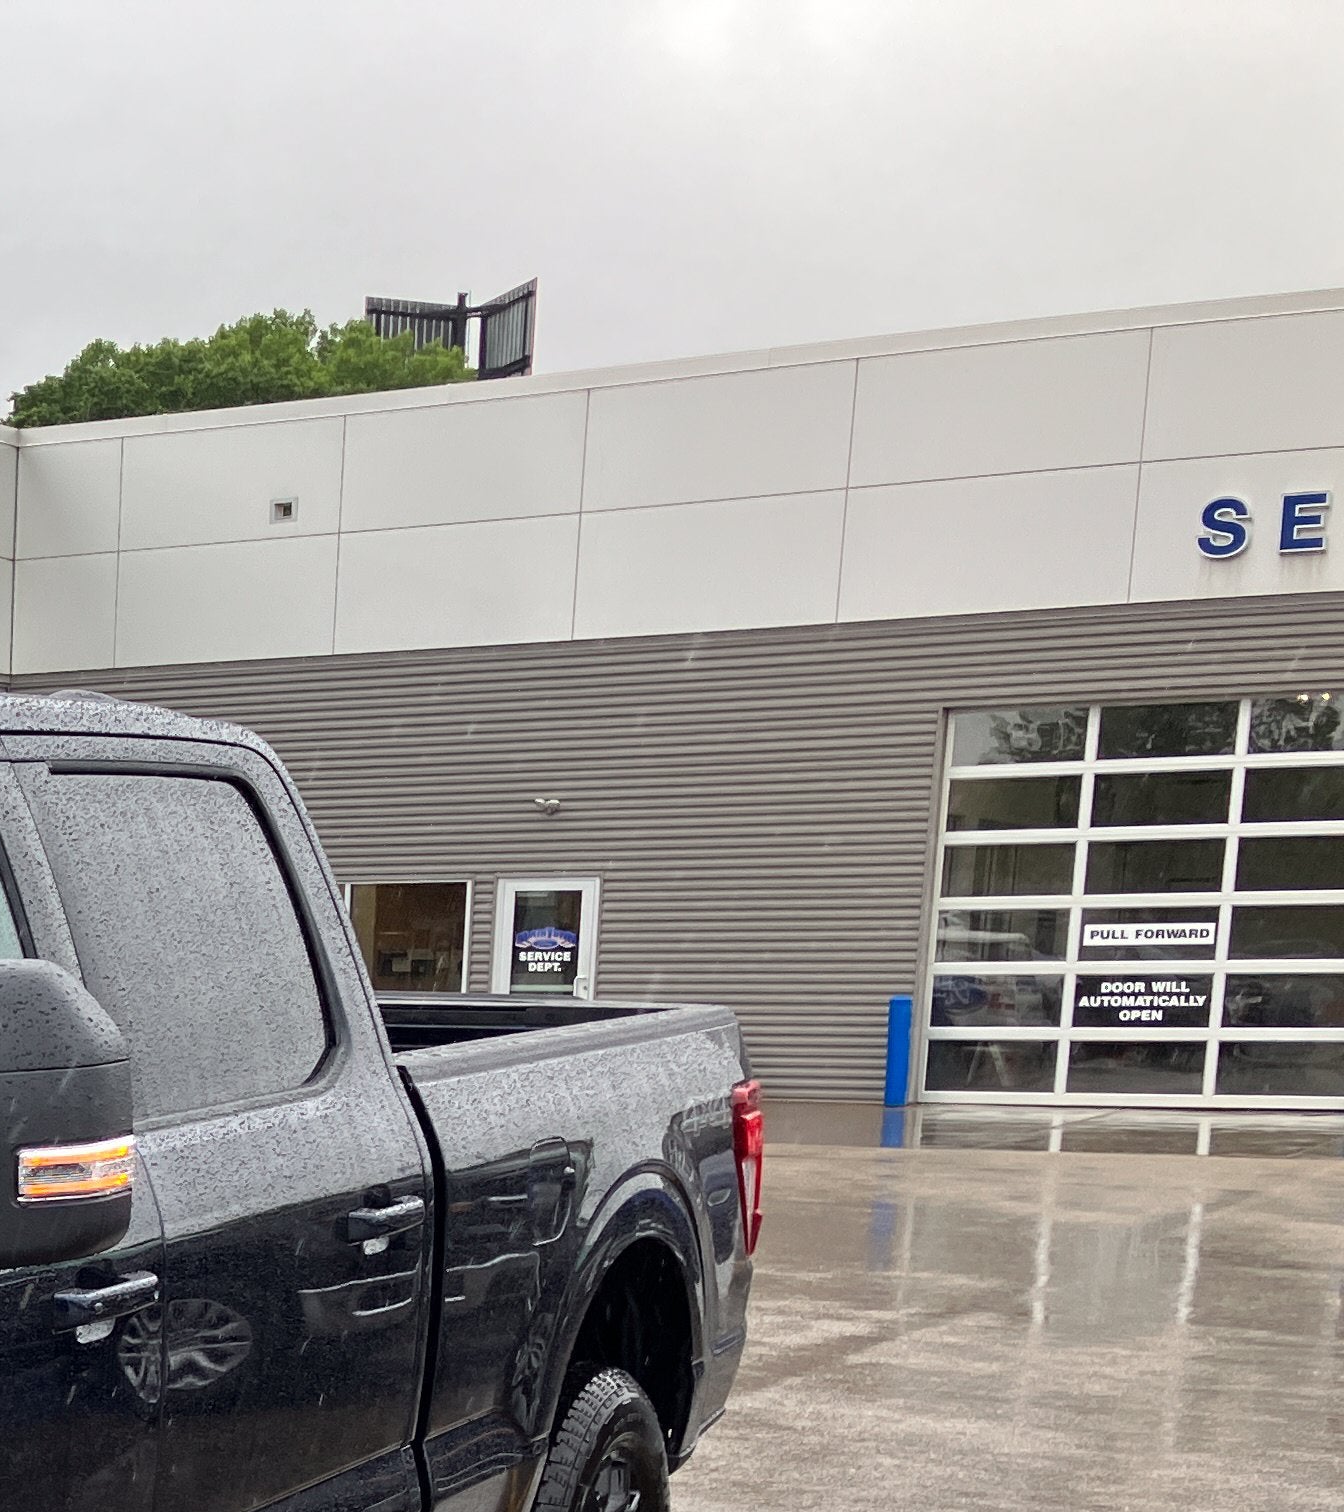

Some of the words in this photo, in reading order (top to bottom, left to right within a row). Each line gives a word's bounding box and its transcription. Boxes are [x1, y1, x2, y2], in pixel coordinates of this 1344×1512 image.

[1197, 490, 1330, 559] SE
[1089, 929, 1129, 940] PULL
[1134, 928, 1210, 940] FORWARD
[518, 951, 572, 962] SERVICE
[527, 962, 562, 972] DEPT.
[1100, 981, 1146, 994] DOOR
[1151, 981, 1190, 993] WILL
[1078, 995, 1207, 1008] AUTOMATICALLY
[1118, 1009, 1164, 1022] OPEN
